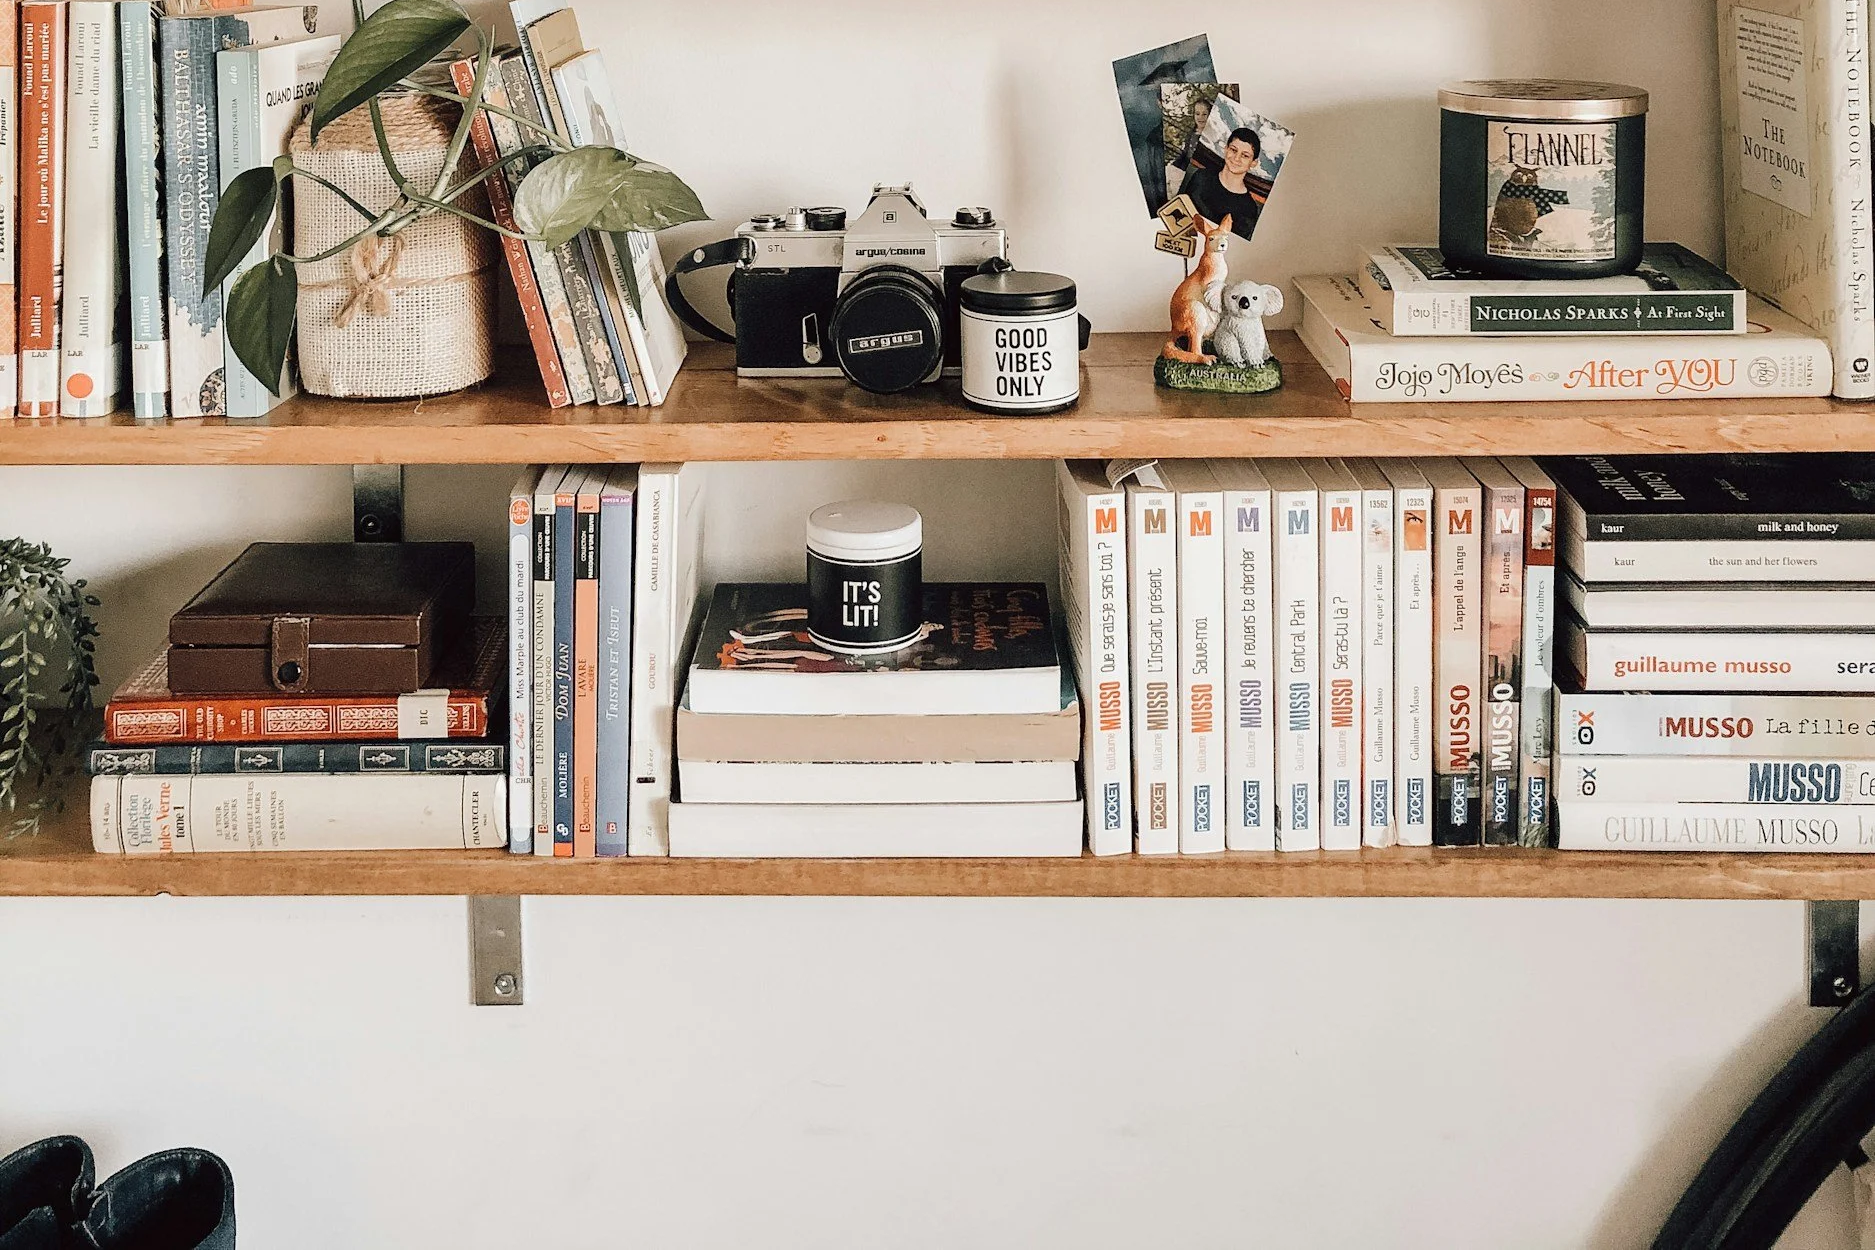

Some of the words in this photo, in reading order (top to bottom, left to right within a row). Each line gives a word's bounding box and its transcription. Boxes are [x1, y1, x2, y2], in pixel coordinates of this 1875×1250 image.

[174, 49, 193, 184] BALTHASAR'S
[266, 90, 292, 107] QUAND
[1847, 49, 1861, 168] NOTEBOOK
[196, 103, 212, 151] amin
[1503, 126, 1602, 166] FLANNEL
[1762, 117, 1785, 145] THE
[1743, 135, 1806, 178] NOTEBOOK
[178, 191, 196, 285] ODYSSEY
[767, 244, 786, 253] STL
[1851, 199, 1864, 265] Nicholas
[30, 295, 42, 338] Julliard
[1476, 306, 1561, 321] NICHOLAS
[1565, 305, 1628, 320] SPARKS
[1666, 306, 1692, 319] First
[1695, 306, 1725, 321] Sight
[1849, 272, 1867, 322] Sparks
[859, 333, 914, 350] argus
[995, 328, 1047, 349] GOOD
[996, 351, 1053, 373] VIBES
[1190, 369, 1246, 382] AUSTRALIA
[1375, 362, 1433, 397] Jojo
[1563, 360, 1649, 389] After
[1654, 359, 1738, 395] YOU
[996, 375, 1046, 397] ONLY
[652, 490, 661, 544] CASABIANCA
[1369, 500, 1388, 508] 13562
[1601, 523, 1624, 533] kaur
[1757, 522, 1782, 533] milk
[1784, 522, 1804, 532] and
[1806, 521, 1839, 534] honey
[1240, 548, 1255, 596] chercher
[1614, 557, 1635, 567] kaur
[1782, 557, 1818, 567] flowers
[842, 580, 882, 604] IT'S
[1148, 568, 1165, 614] présent
[842, 604, 880, 628] LIT!
[556, 642, 569, 681] JUAN
[1147, 617, 1163, 673] L'Instant
[1290, 631, 1306, 674] Central
[1614, 656, 1717, 678] guillaume
[1724, 659, 1792, 674] musso
[556, 682, 569, 721] DOM
[607, 666, 620, 722] TRISTAN
[1099, 681, 1121, 731] MUSSO
[1146, 681, 1169, 731] MUSSO
[1191, 683, 1213, 733] MUSSO
[1239, 679, 1262, 728] MUSSO
[1289, 682, 1310, 731] MUSSO
[1331, 678, 1353, 727] MUSSO
[1450, 685, 1471, 767] MUSSO
[1491, 683, 1514, 763] MUSSO
[1665, 717, 1754, 739] MUSSO
[1766, 718, 1791, 734] La
[1798, 718, 1859, 735] fille
[157, 782, 171, 821] Verne
[1246, 781, 1260, 827] POCKET
[1748, 763, 1842, 803] MUSSO
[128, 794, 140, 847] Collection
[472, 790, 480, 846] CHANTECLER
[1107, 782, 1121, 830] POCKET
[1604, 816, 1746, 844] GUILLAUME
[1757, 818, 1839, 845] MUSSO
